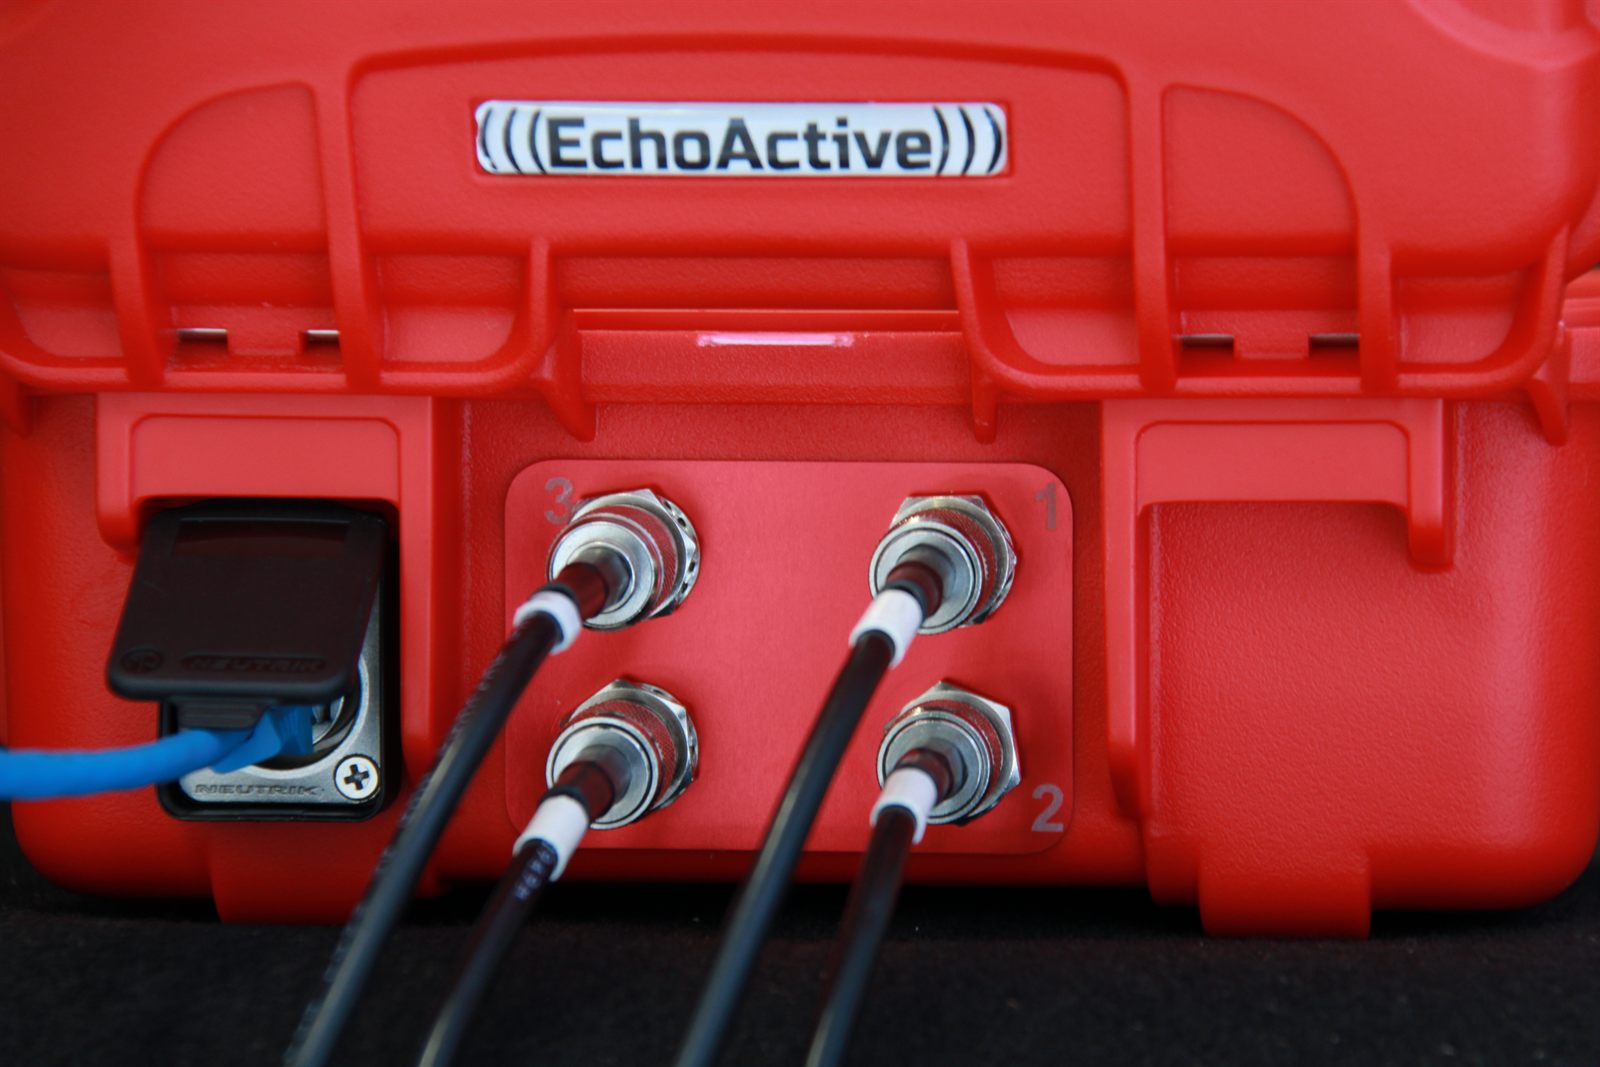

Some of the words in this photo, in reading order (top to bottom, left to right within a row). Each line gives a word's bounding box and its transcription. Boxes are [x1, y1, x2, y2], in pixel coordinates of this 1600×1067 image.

[546, 116, 932, 169] EchoActive
[544, 477, 573, 525] 3
[1034, 483, 1056, 529] 1
[194, 784, 321, 796] NEUTRIK
[1032, 783, 1064, 832] 2
